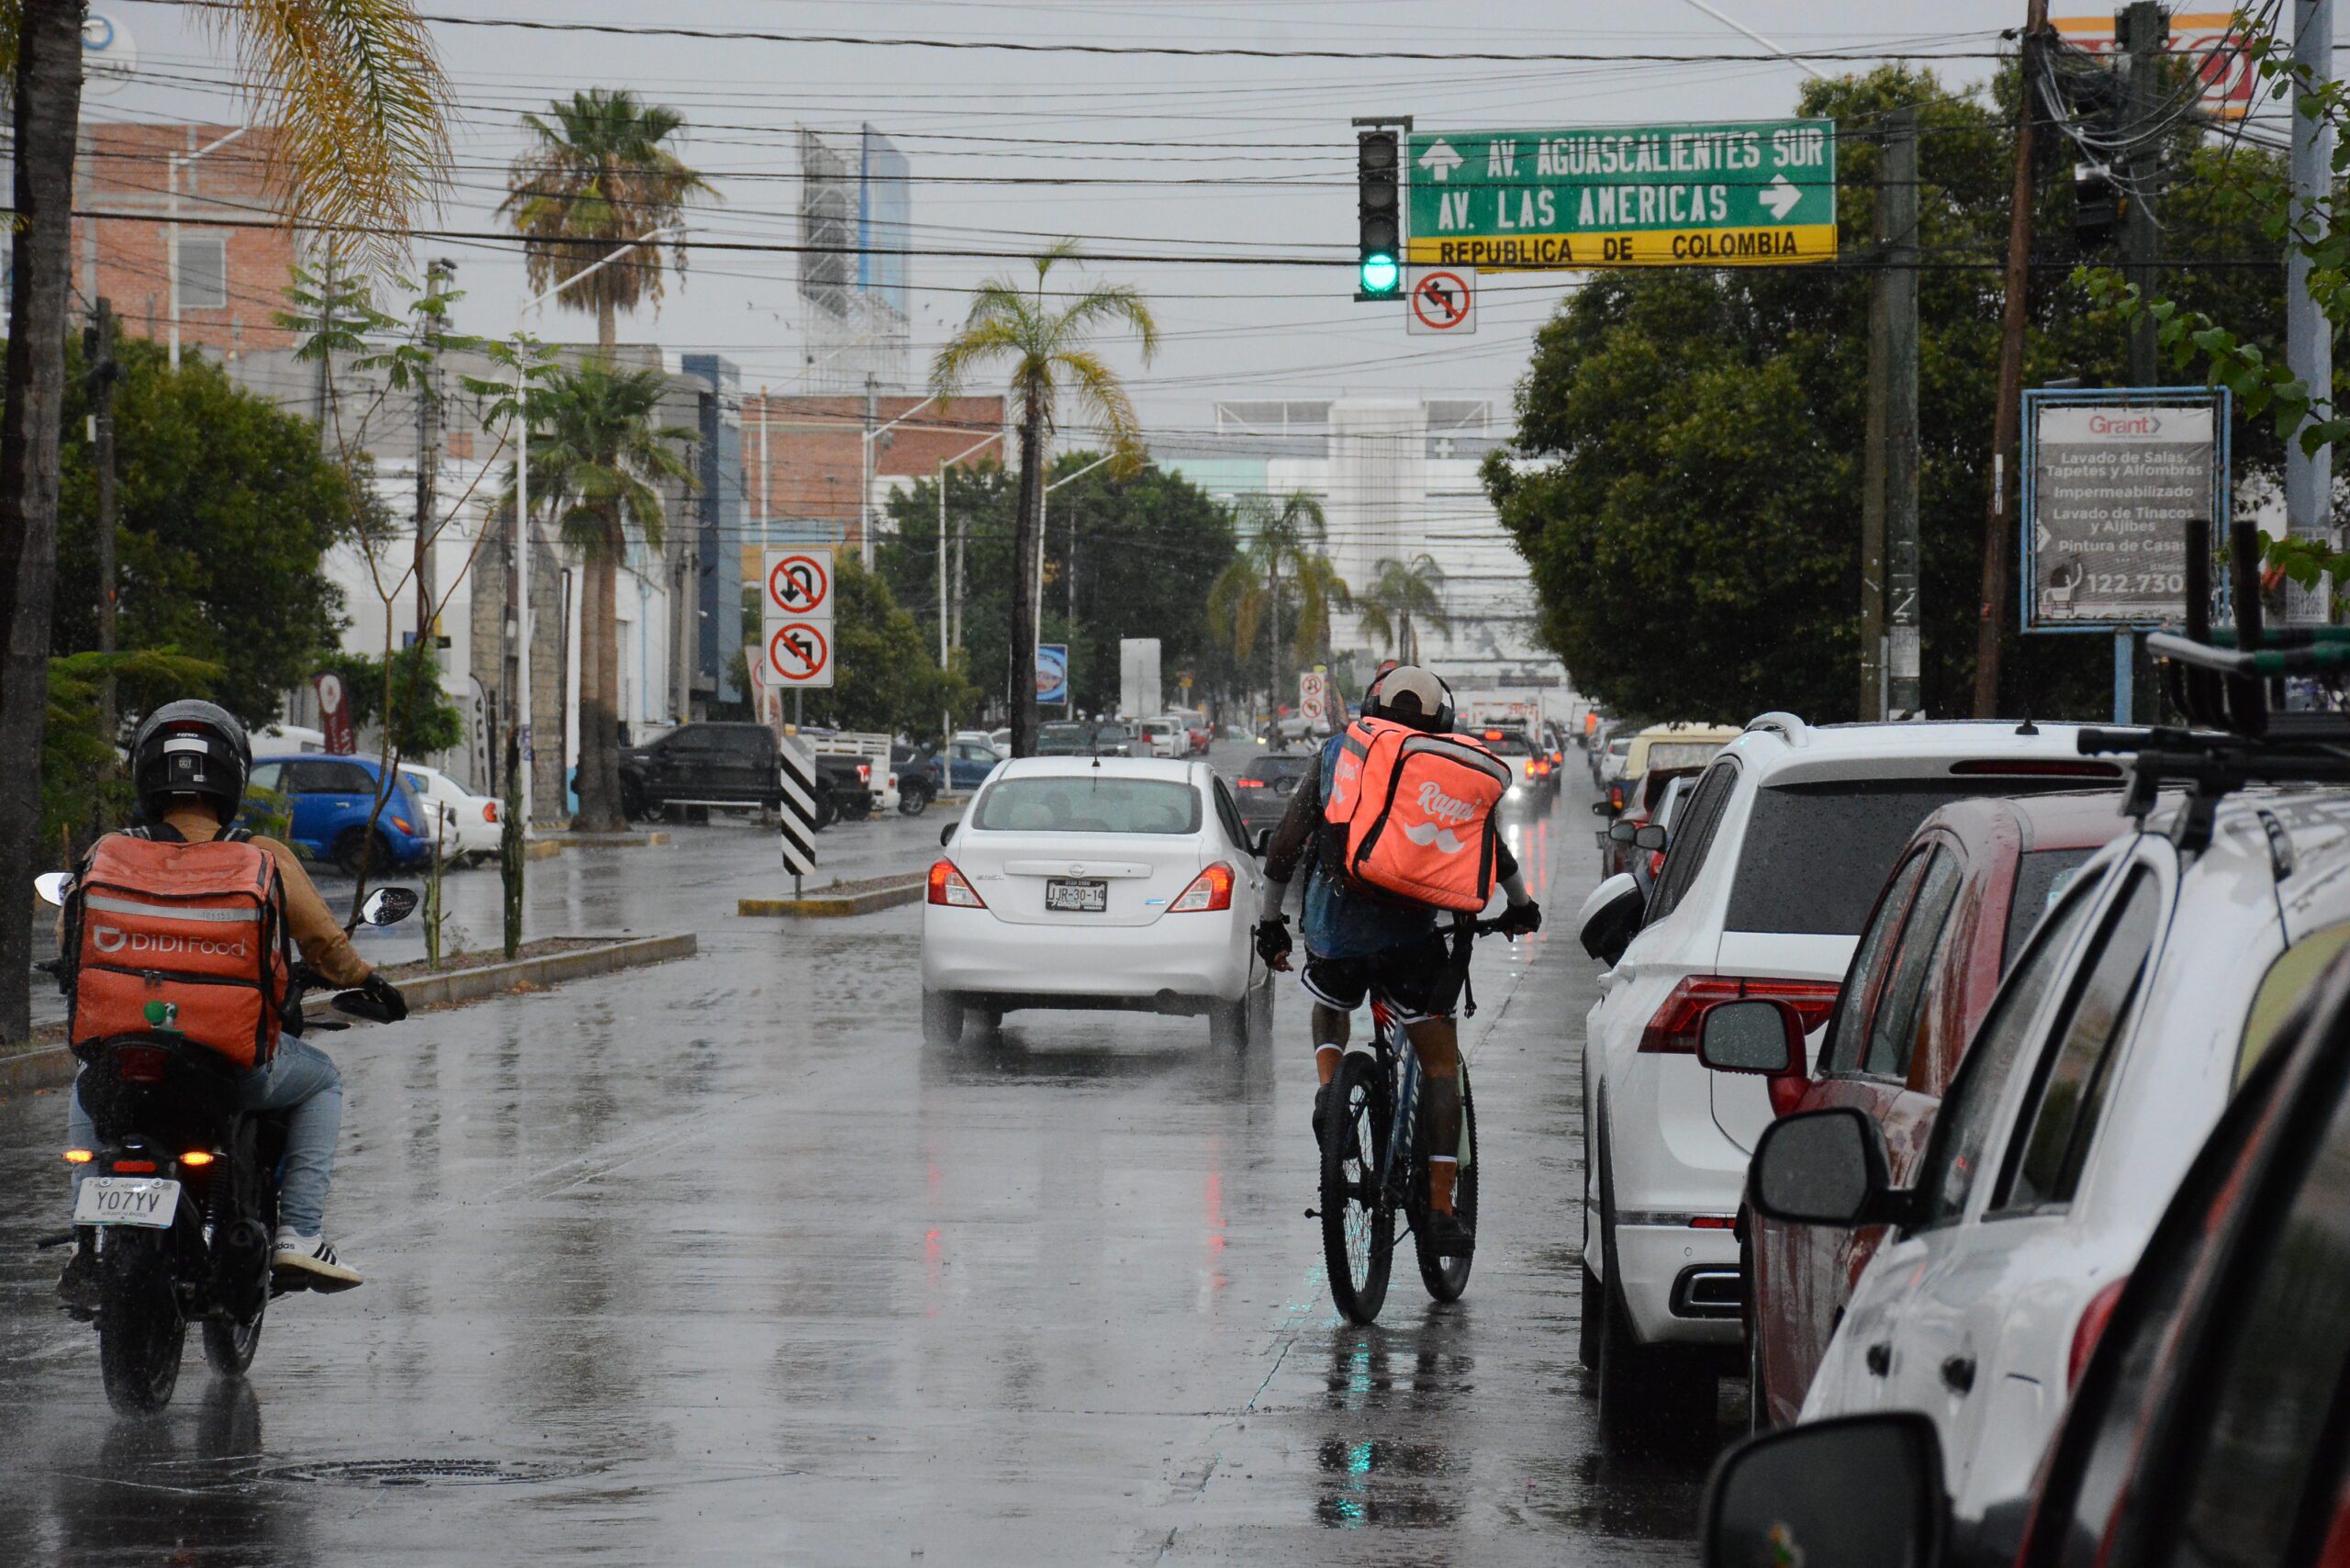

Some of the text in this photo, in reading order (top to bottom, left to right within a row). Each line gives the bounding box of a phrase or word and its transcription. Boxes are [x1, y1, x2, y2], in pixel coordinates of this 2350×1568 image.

[1487, 128, 1823, 178] AV. AGUASCALIENTES SUR
[1438, 185, 1728, 230] AV. LAS AMERICAS
[1440, 231, 1797, 263] REPUBLICA DE COLOMBIA
[2089, 416, 2149, 434] Grant
[2062, 452, 2188, 464] Lavado de Salas,
[2046, 465, 2203, 478] Tapetes y Alfombras
[2054, 486, 2194, 499] Impermeabilizado
[2053, 507, 2194, 520] Lavado de Tinacos
[2091, 520, 2156, 535] y Aljibes
[2059, 540, 2187, 552] Pintura de Casas
[1416, 781, 1483, 824] Rappi
[1049, 888, 1104, 902] JJR-30-14
[131, 933, 247, 957] DiDi Food
[97, 1191, 160, 1213] Y07YV
